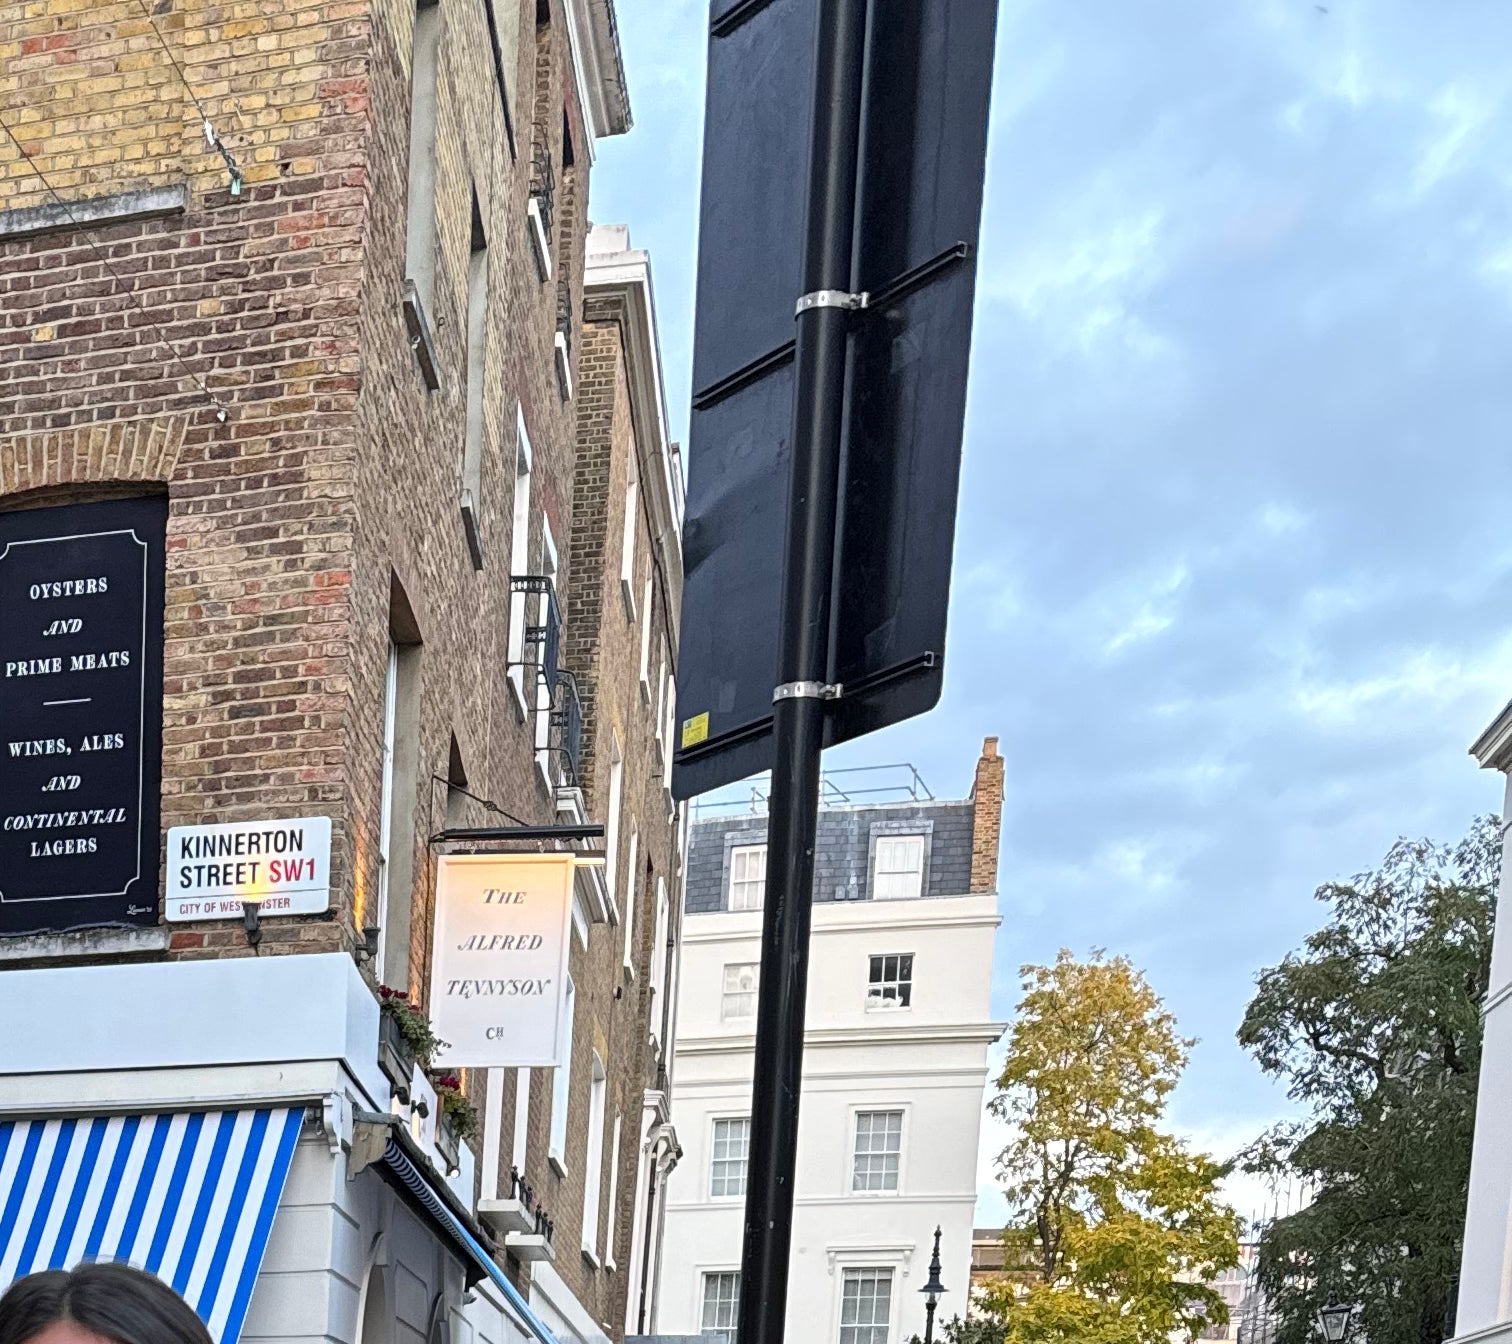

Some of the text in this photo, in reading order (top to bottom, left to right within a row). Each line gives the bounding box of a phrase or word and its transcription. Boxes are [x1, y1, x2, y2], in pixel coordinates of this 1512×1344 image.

[29, 577, 108, 600] OYSTERS
[43, 618, 83, 636] AND
[5, 651, 130, 678] PRIME MEATS
[7, 733, 124, 758] WINES, ALES
[41, 775, 81, 792] AND
[3, 807, 127, 831] CONTINENTAL
[29, 837, 98, 857] LAGERS
[181, 828, 304, 859] KINNERTON
[180, 858, 315, 889] STREET SW1
[482, 888, 527, 905] THE
[179, 902, 201, 915] CITY
[204, 901, 217, 913] OF
[457, 934, 543, 951] ALFRED
[446, 979, 552, 1000] TENNYSON
